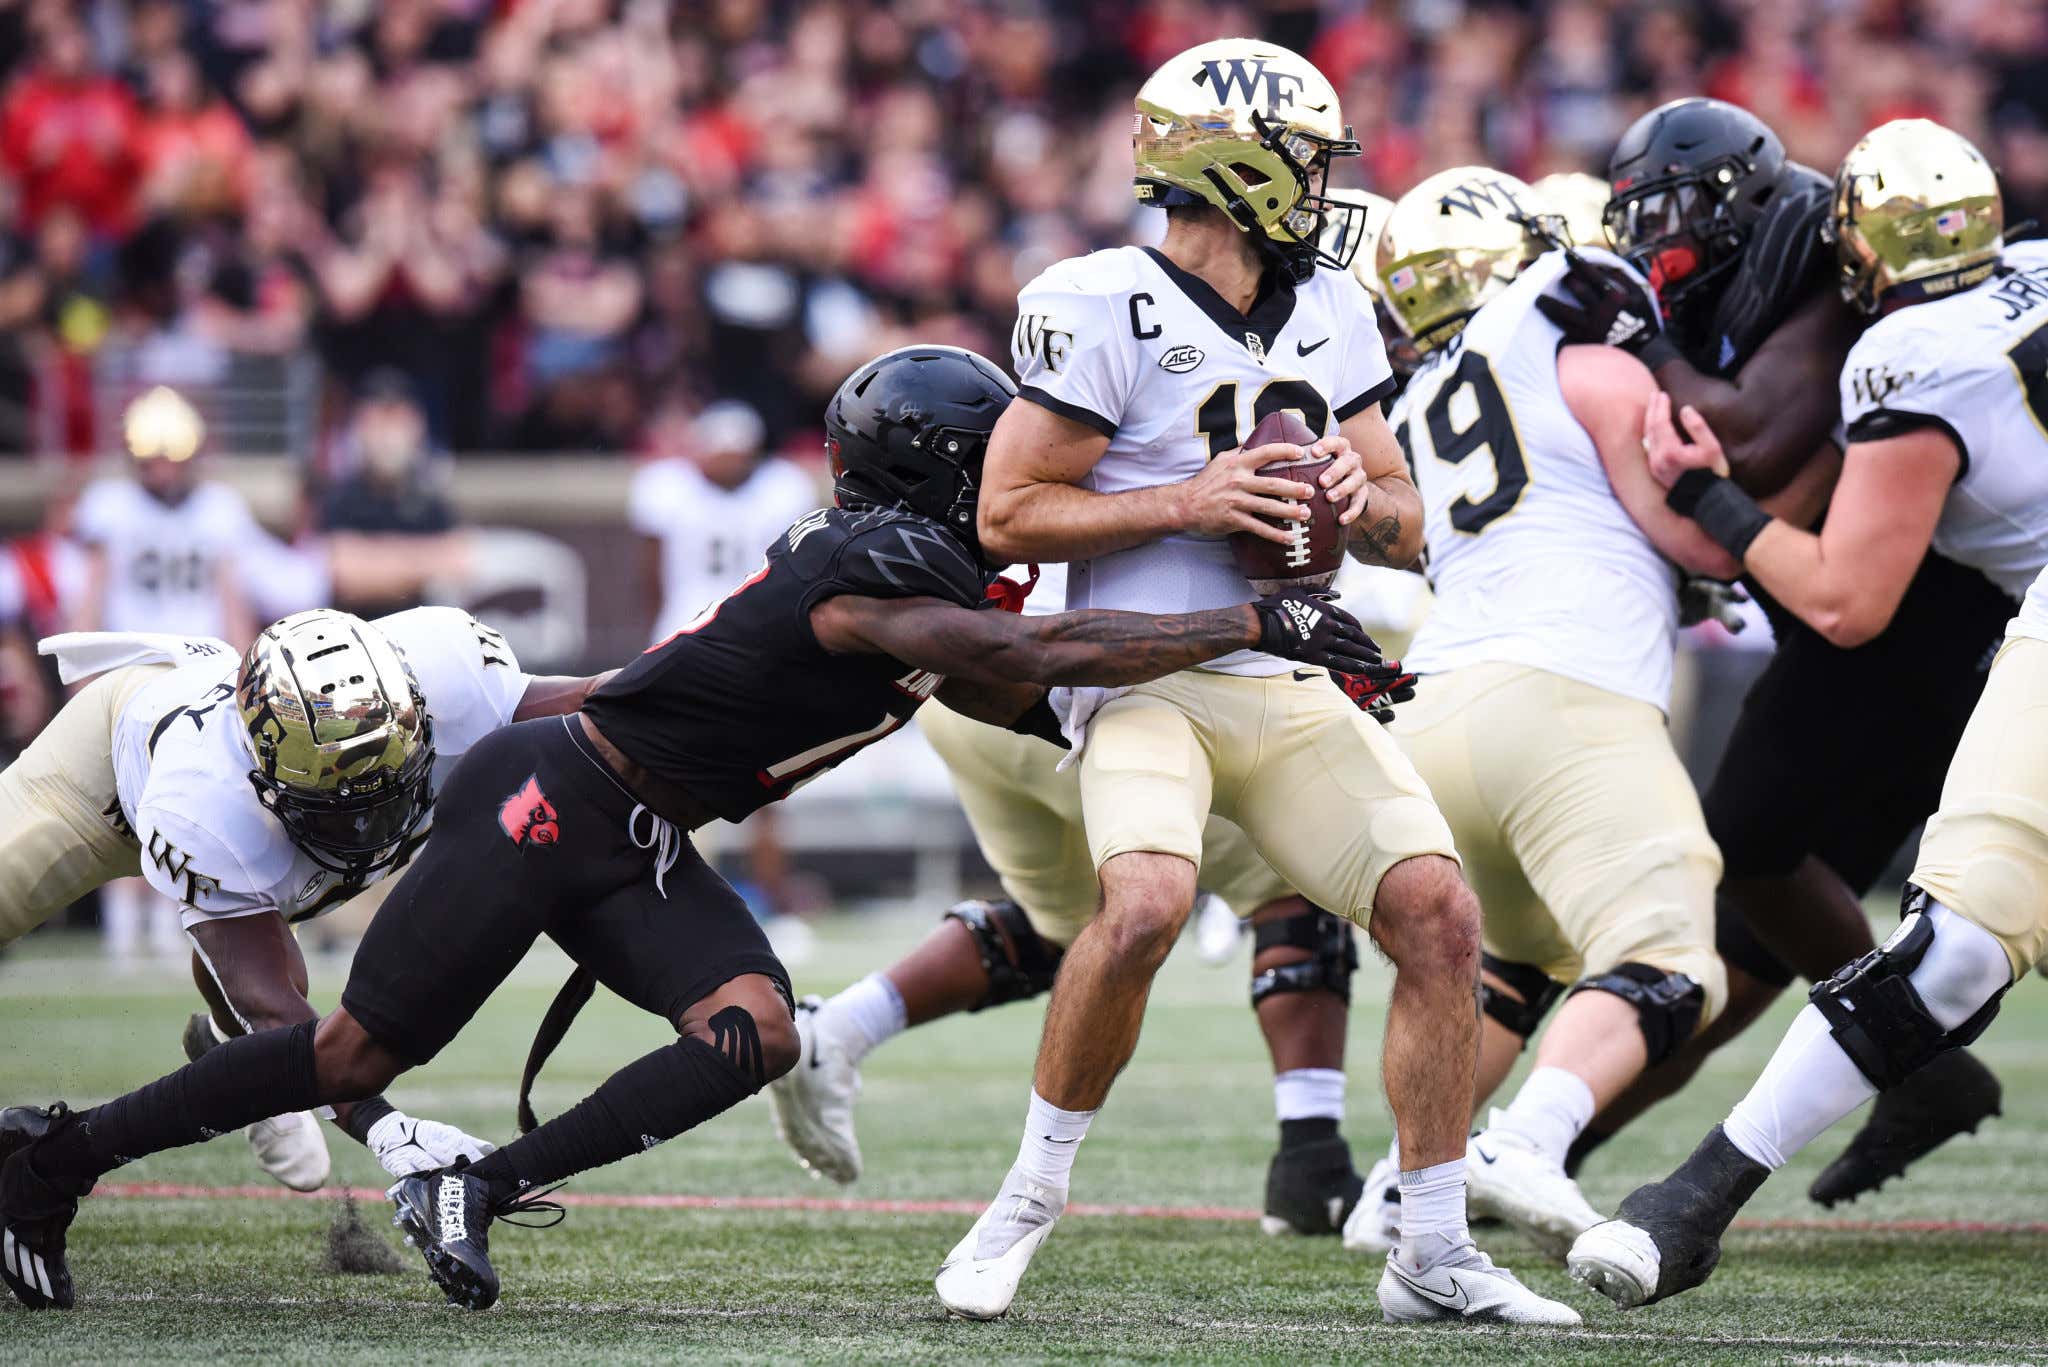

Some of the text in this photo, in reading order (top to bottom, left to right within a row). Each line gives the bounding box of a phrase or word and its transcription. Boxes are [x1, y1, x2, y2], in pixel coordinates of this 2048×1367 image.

[1200, 58, 1305, 125] WF
[1128, 291, 1163, 341] C
[1017, 313, 1075, 376] WF
[1165, 349, 1198, 365] ACC
[1281, 599, 1311, 641] adidas
[147, 825, 222, 907] WF
